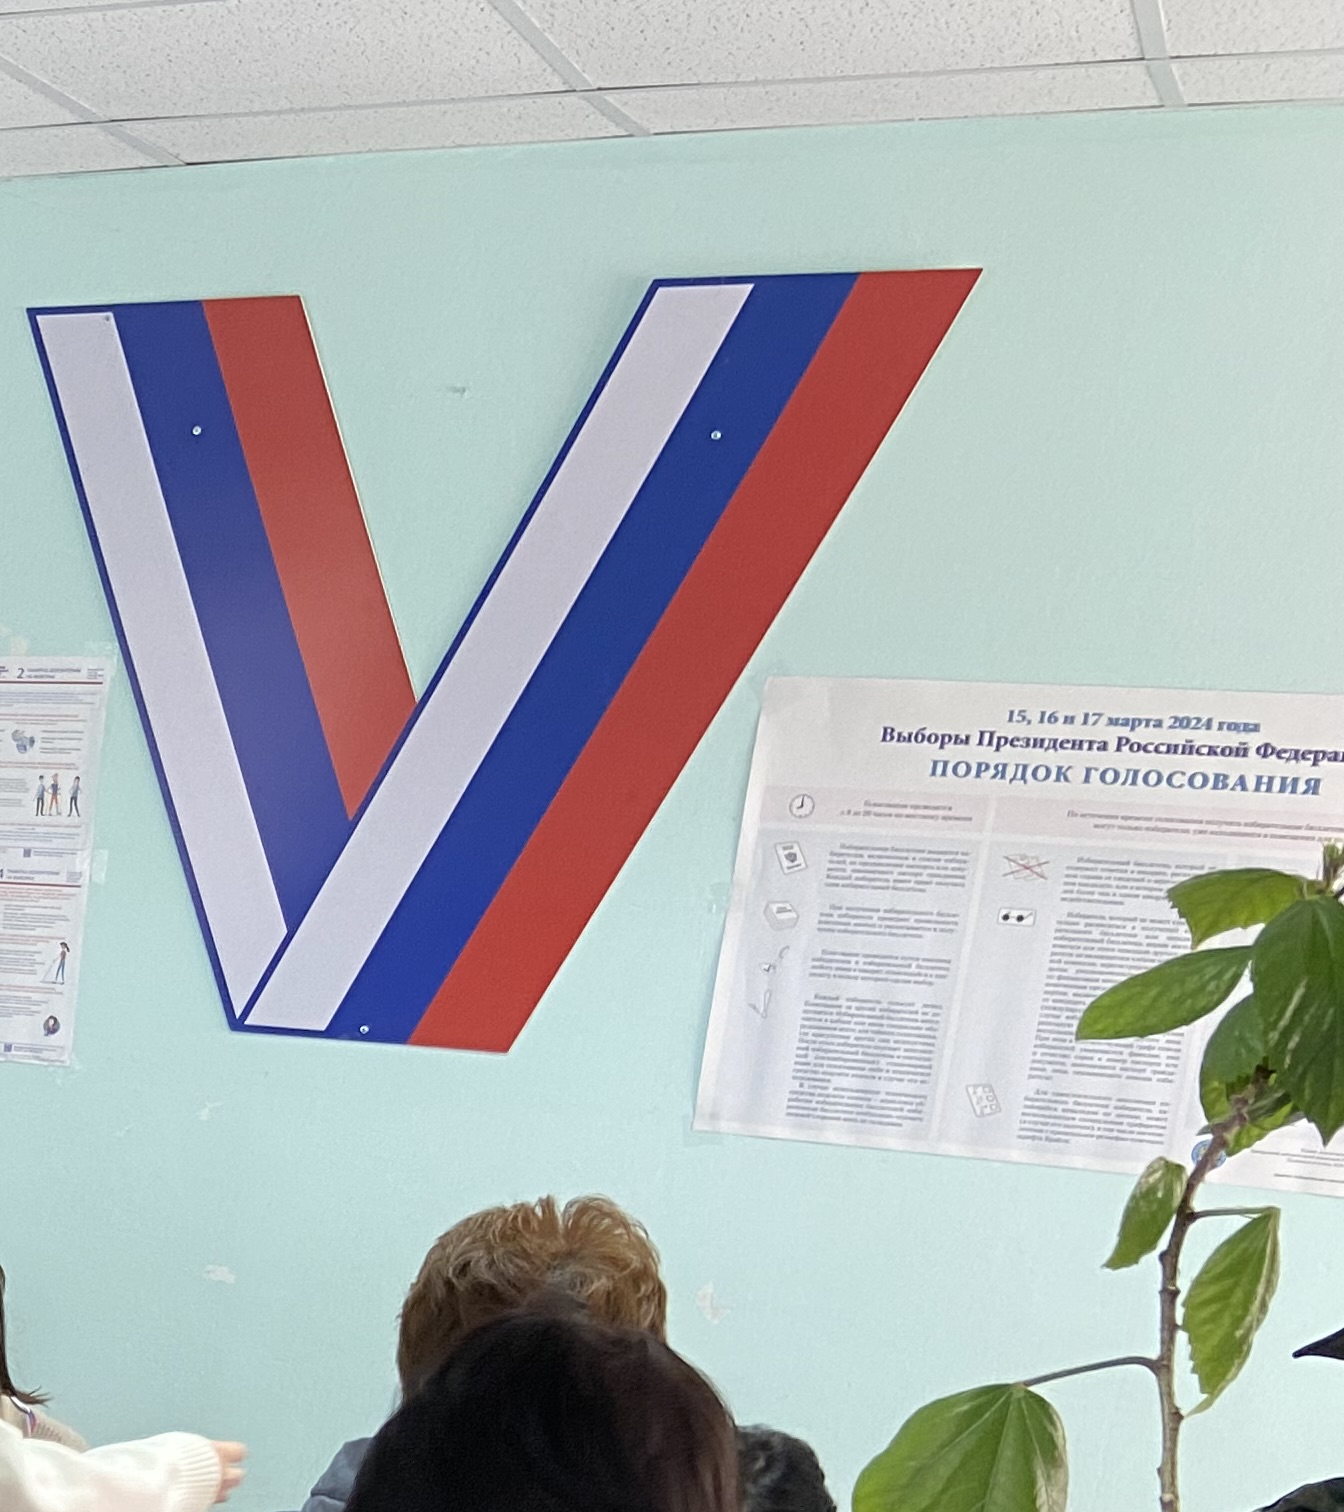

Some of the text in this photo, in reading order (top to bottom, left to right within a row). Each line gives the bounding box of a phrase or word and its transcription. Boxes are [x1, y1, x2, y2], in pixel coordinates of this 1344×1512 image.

[1006, 708, 1261, 734] 15, 16 и 17 марта 2024 года
[880, 725, 1344, 767] Выборы Президента Российской Федера
[928, 759, 1323, 796] ПОРЯДОК ГОЛОСОВАНИЯ
